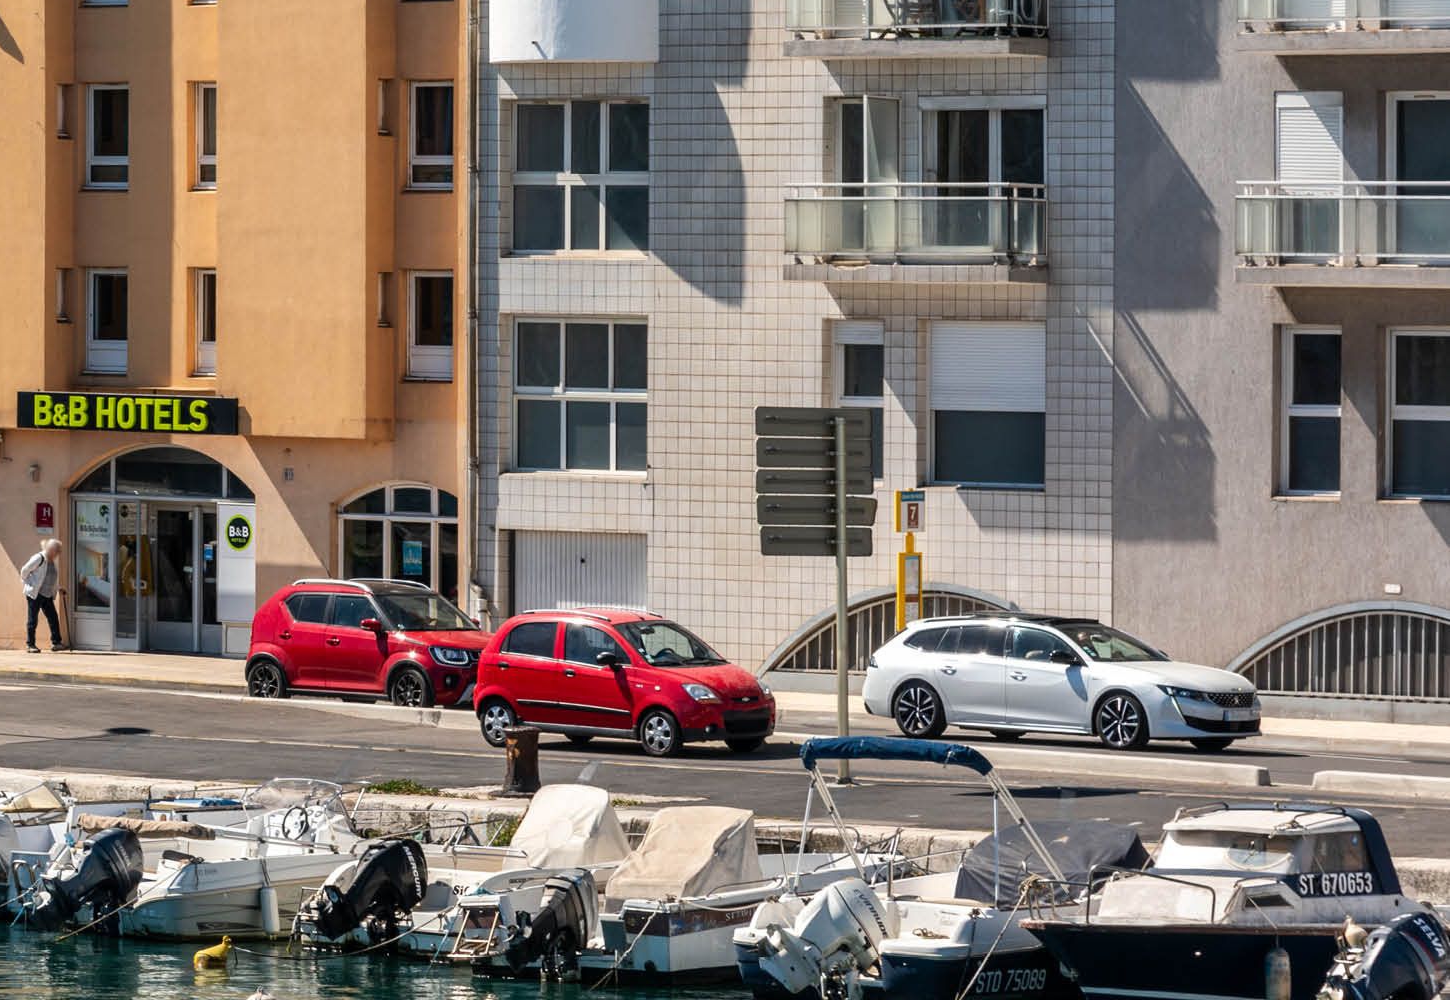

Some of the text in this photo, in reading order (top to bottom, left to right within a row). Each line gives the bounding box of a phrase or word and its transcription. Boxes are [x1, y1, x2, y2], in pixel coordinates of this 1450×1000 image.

[34, 394, 208, 431] B&B HOTELS
[43, 507, 51, 517] H
[910, 506, 917, 520] 7
[229, 526, 249, 538] B&B
[402, 846, 422, 899] MERCURY
[1300, 872, 1373, 895] ST 670653
[853, 888, 889, 937] EVINRUDE
[1413, 917, 1447, 958] SELVA
[1004, 969, 1047, 992] 75089
